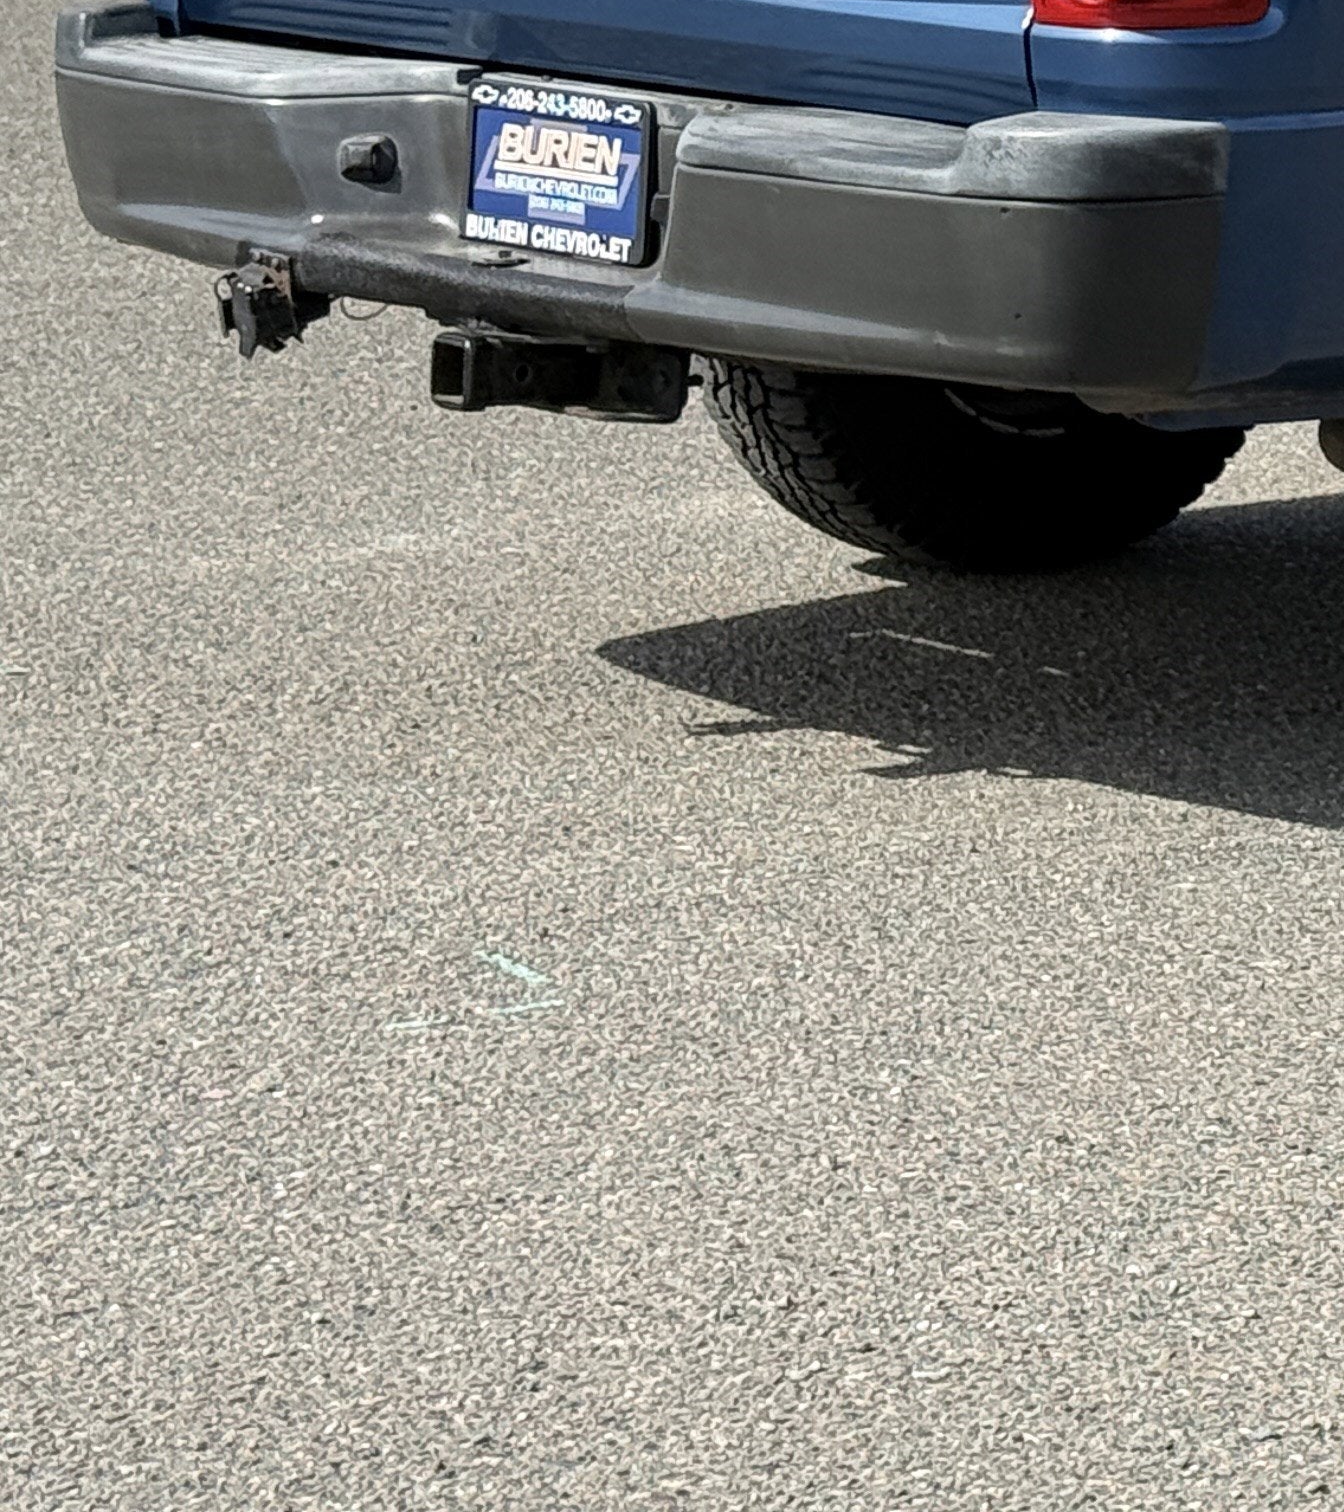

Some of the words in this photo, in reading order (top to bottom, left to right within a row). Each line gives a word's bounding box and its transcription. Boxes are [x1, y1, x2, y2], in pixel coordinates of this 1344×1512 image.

[498, 122, 622, 176] BURIEN
[466, 213, 529, 246] BURIEN
[530, 224, 632, 264] CHEVROLET
